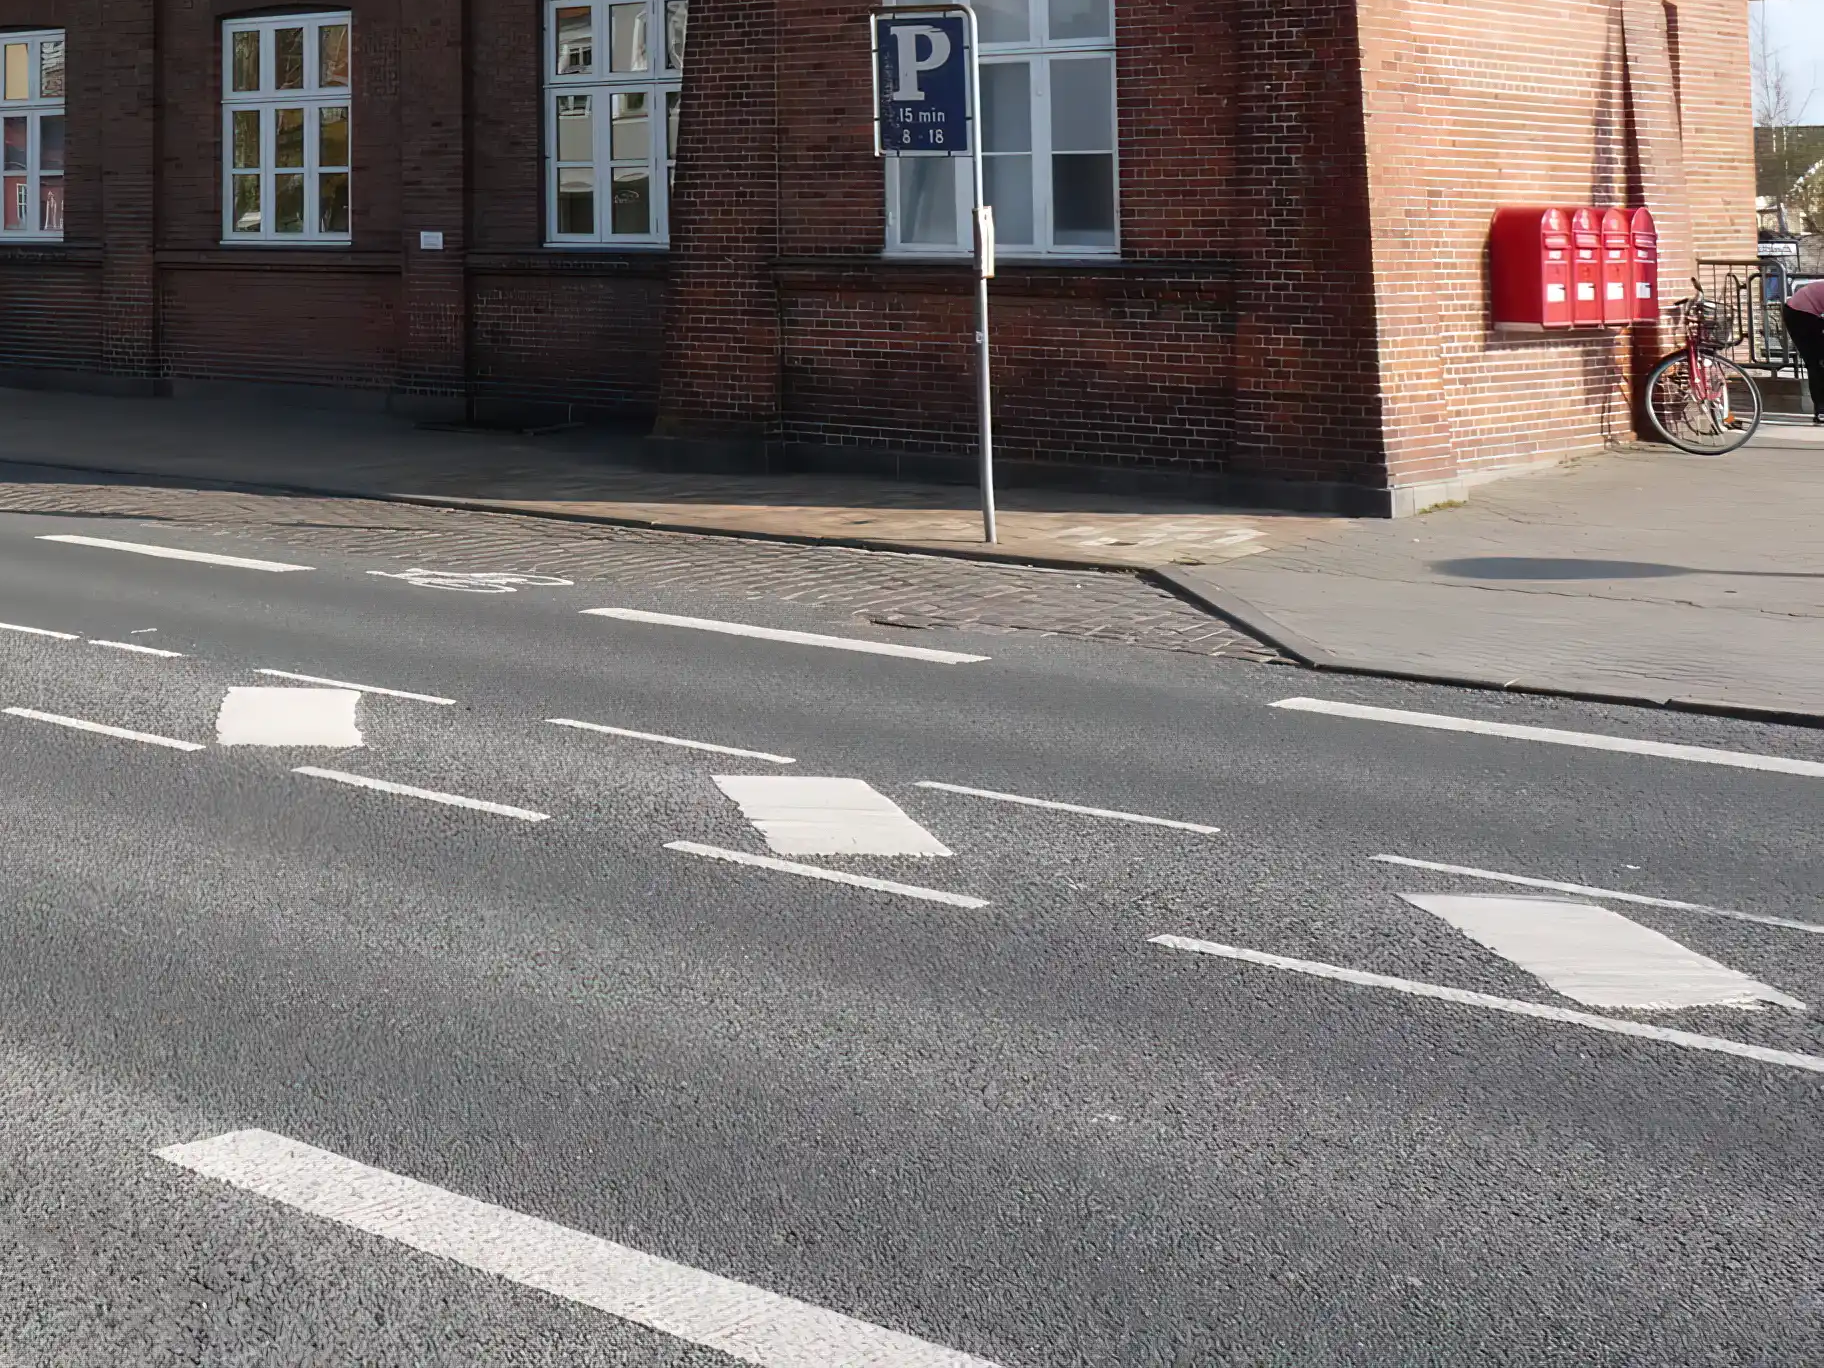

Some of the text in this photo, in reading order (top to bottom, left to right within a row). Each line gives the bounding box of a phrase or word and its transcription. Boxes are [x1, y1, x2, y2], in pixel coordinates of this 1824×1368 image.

[890, 25, 951, 101] P
[899, 107, 946, 123] 15 min
[902, 129, 911, 144] 8
[928, 129, 944, 144] 18
